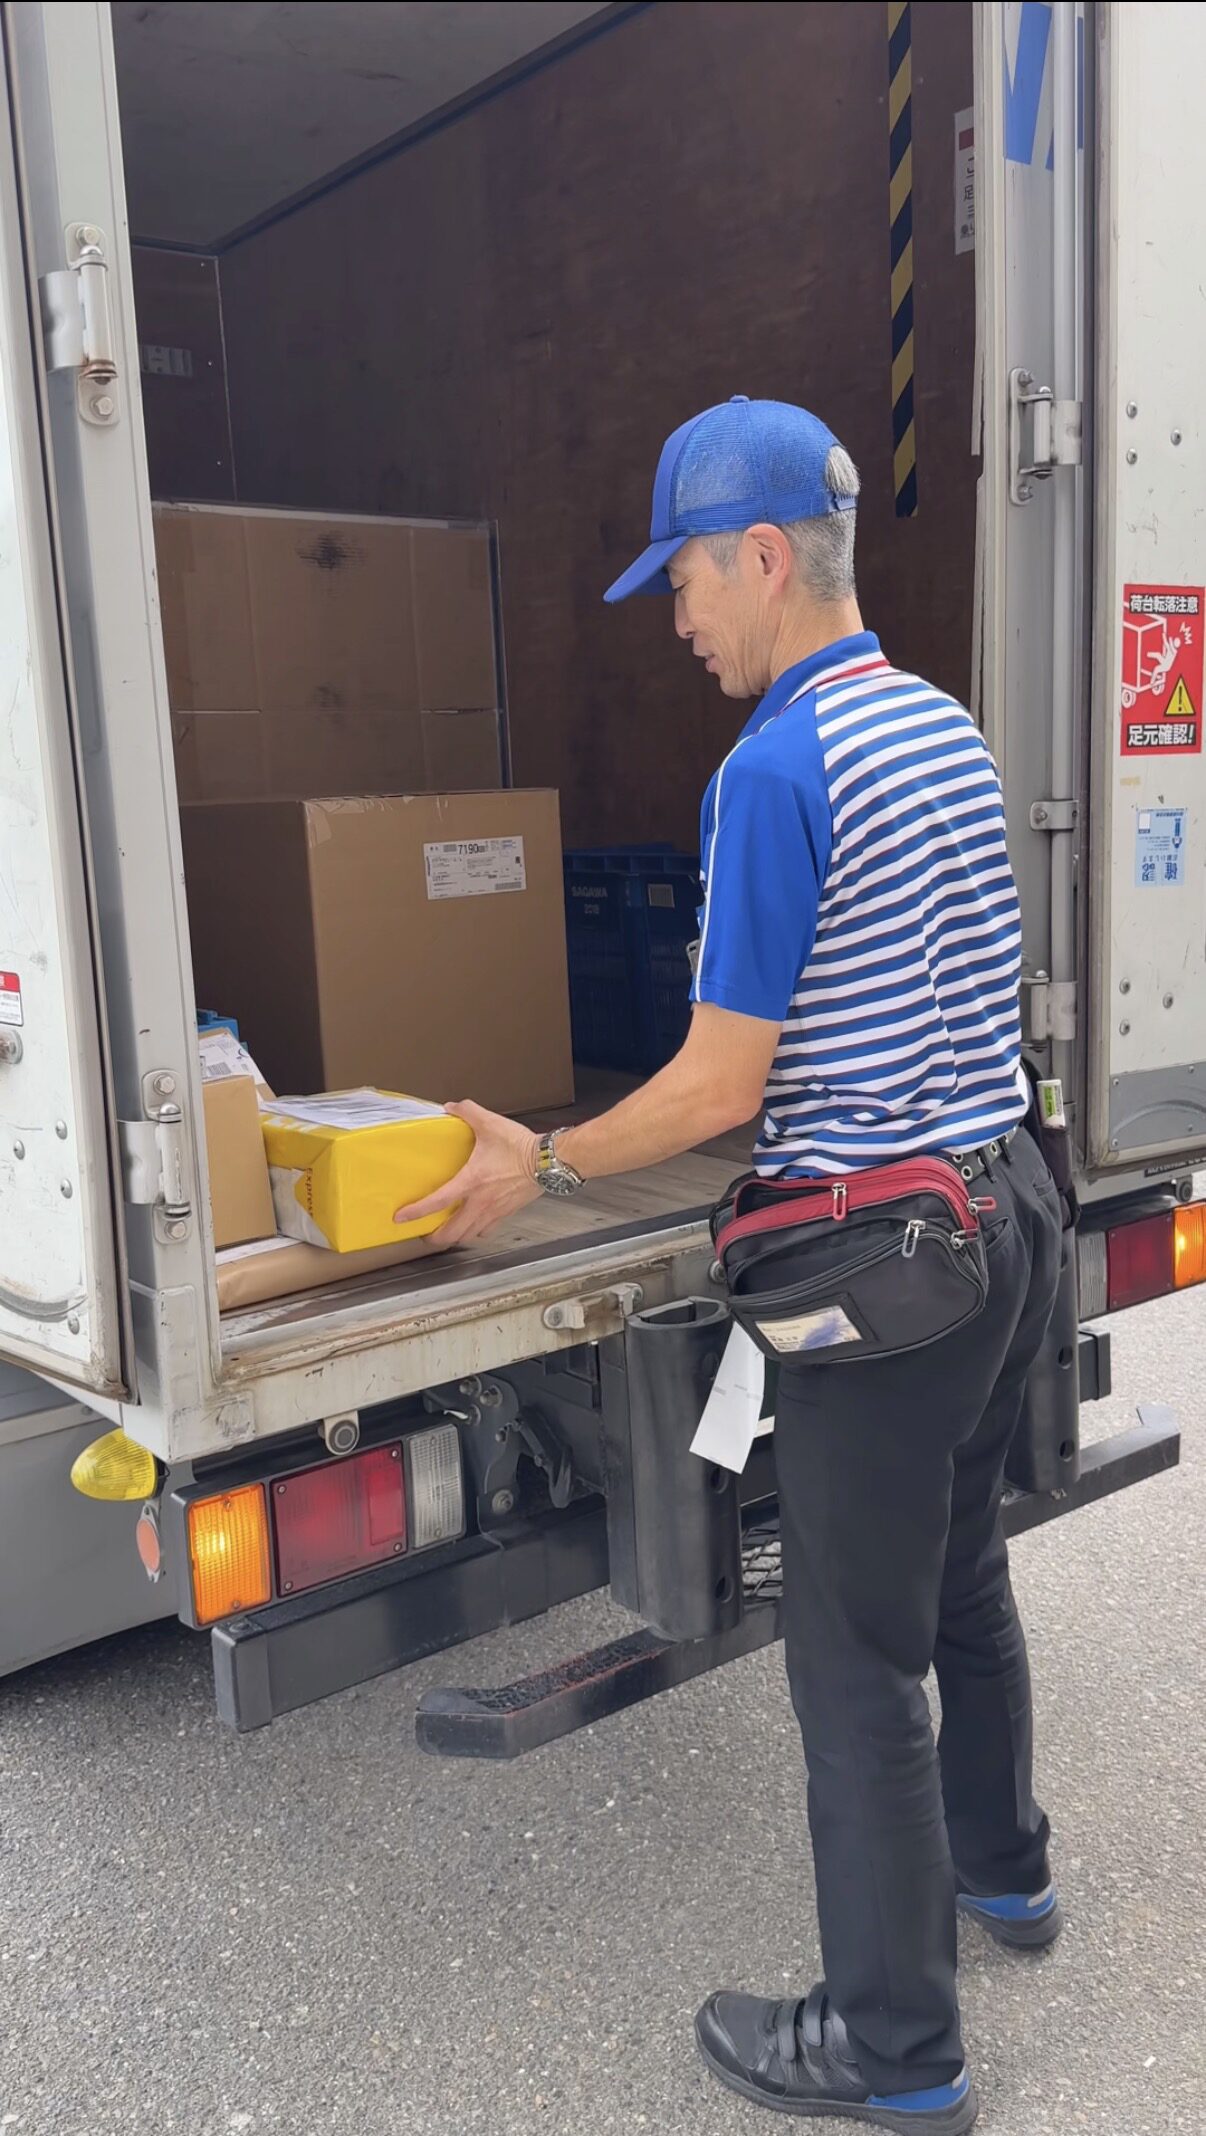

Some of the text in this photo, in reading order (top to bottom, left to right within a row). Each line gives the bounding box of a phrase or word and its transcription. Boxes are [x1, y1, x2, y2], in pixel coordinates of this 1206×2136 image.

[1130, 595, 1198, 613] 荷台転落注意
[1128, 724, 1194, 746] 足元確認!
[571, 886, 608, 898] SAGAWA
